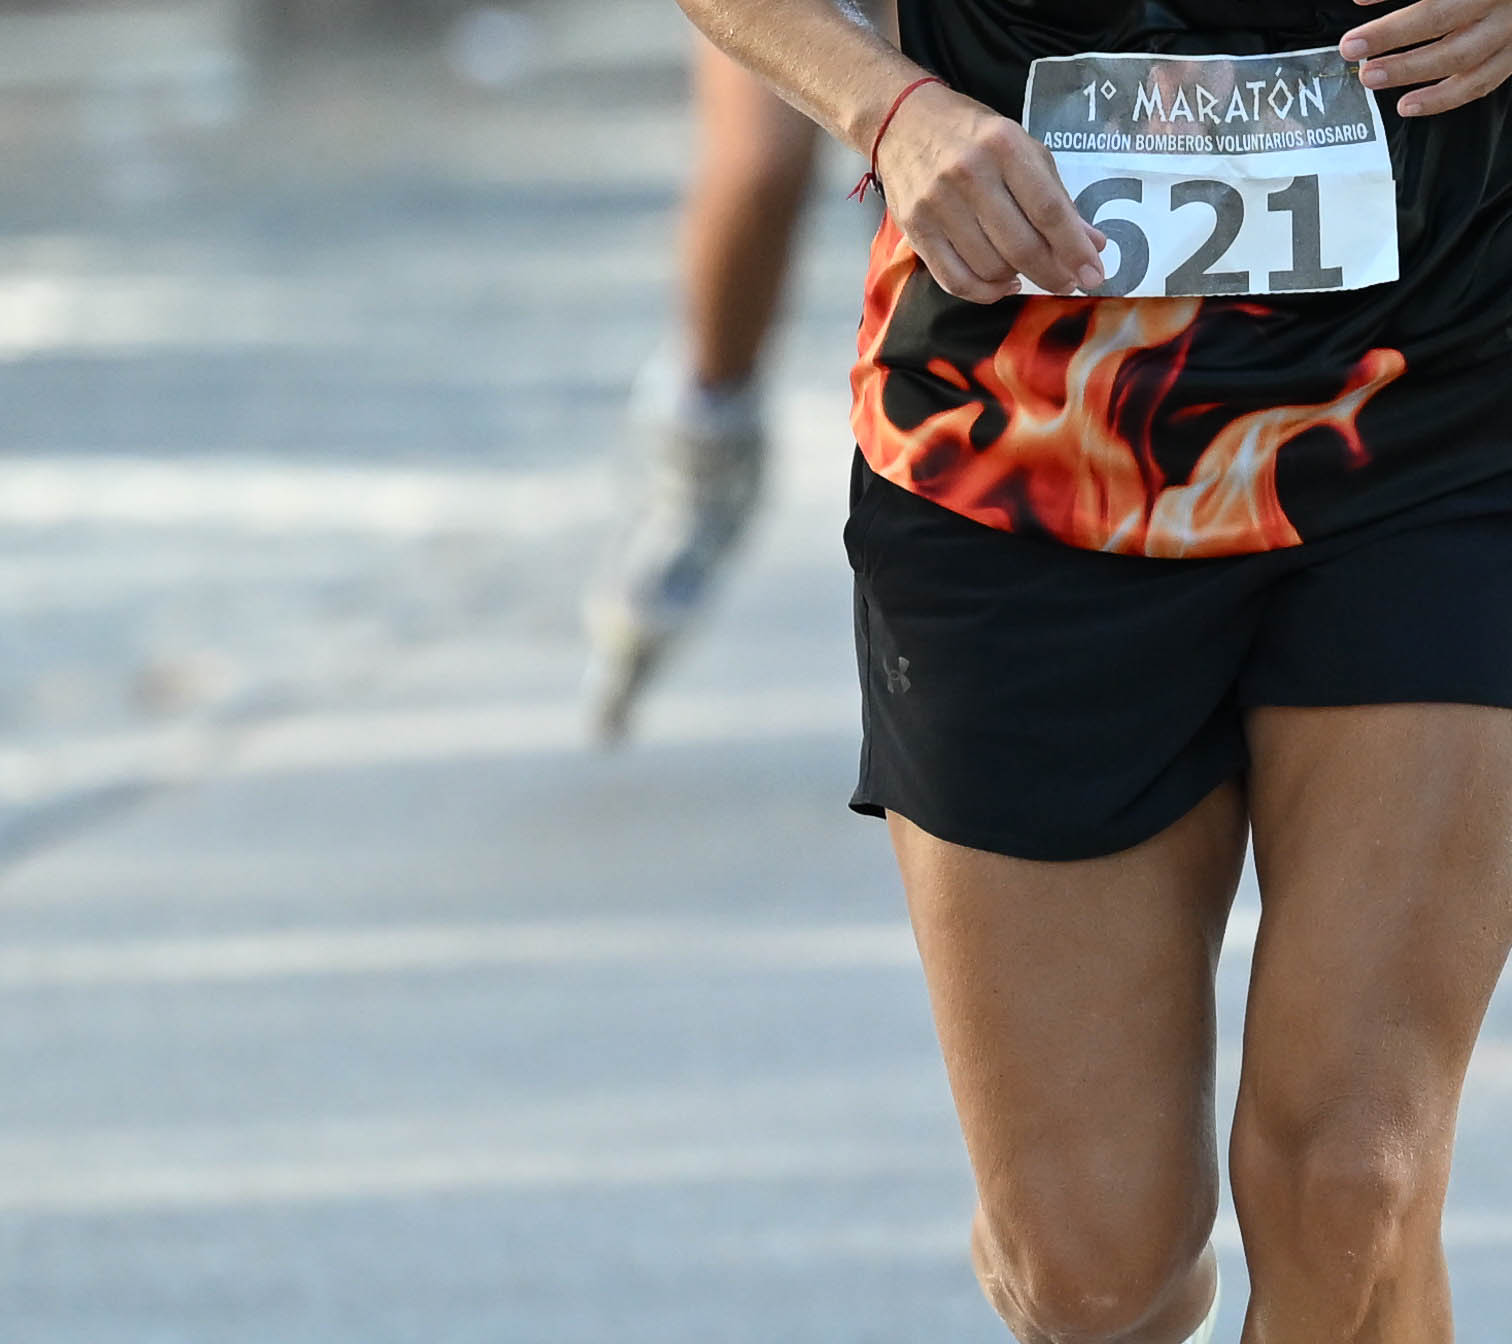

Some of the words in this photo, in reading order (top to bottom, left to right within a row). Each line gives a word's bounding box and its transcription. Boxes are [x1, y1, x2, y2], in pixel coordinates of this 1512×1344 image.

[1132, 66, 1326, 125] MARATÓN
[1043, 130, 1131, 151] ASOCIACIÓN
[1135, 134, 1213, 153] BOMBEROS
[1216, 130, 1303, 153] VOLUNTARIOS
[1306, 123, 1369, 147] ROSARIO
[1072, 173, 1343, 297] 621
